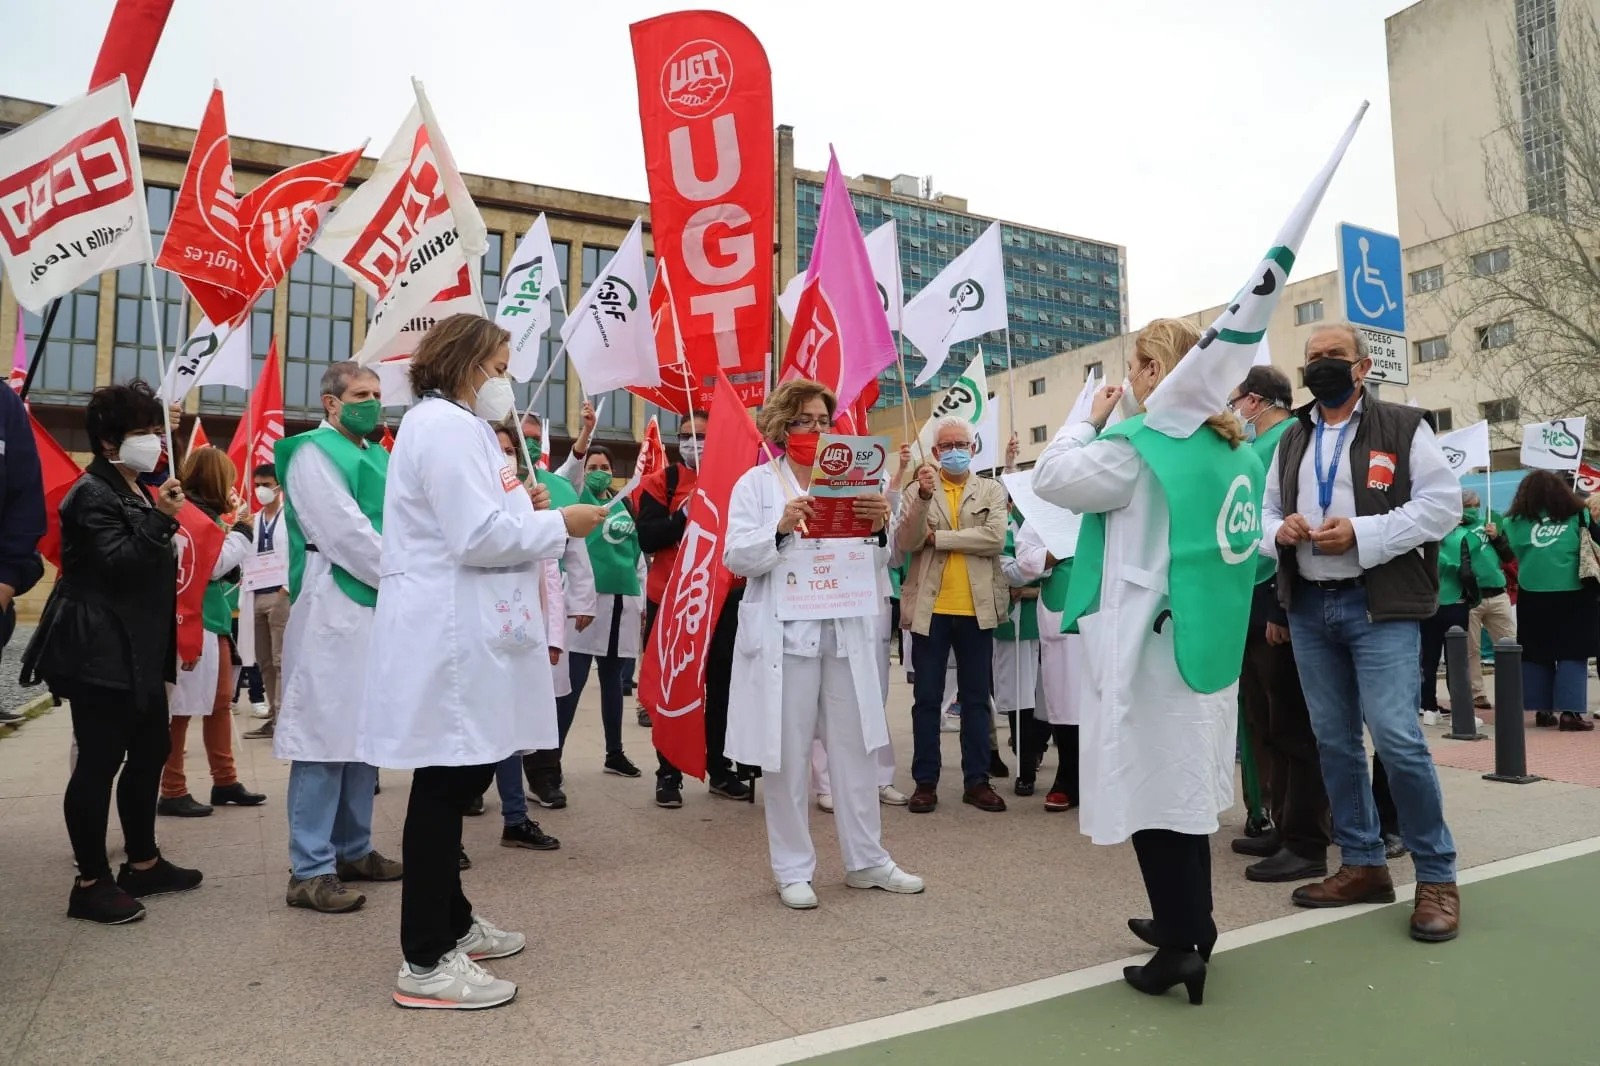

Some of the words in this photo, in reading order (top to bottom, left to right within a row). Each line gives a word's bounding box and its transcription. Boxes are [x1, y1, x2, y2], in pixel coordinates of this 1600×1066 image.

[669, 48, 721, 90] UGT
[668, 113, 757, 369] UGT
[1370, 346, 1383, 355] SEO
[1386, 348, 1396, 358] DE
[1373, 359, 1402, 371] VICENTE
[825, 448, 849, 461] UGT
[1369, 480, 1390, 492] CGT
[1537, 524, 1568, 537] CSIF
[813, 565, 831, 575] SOY
[808, 579, 838, 590] TCAE
